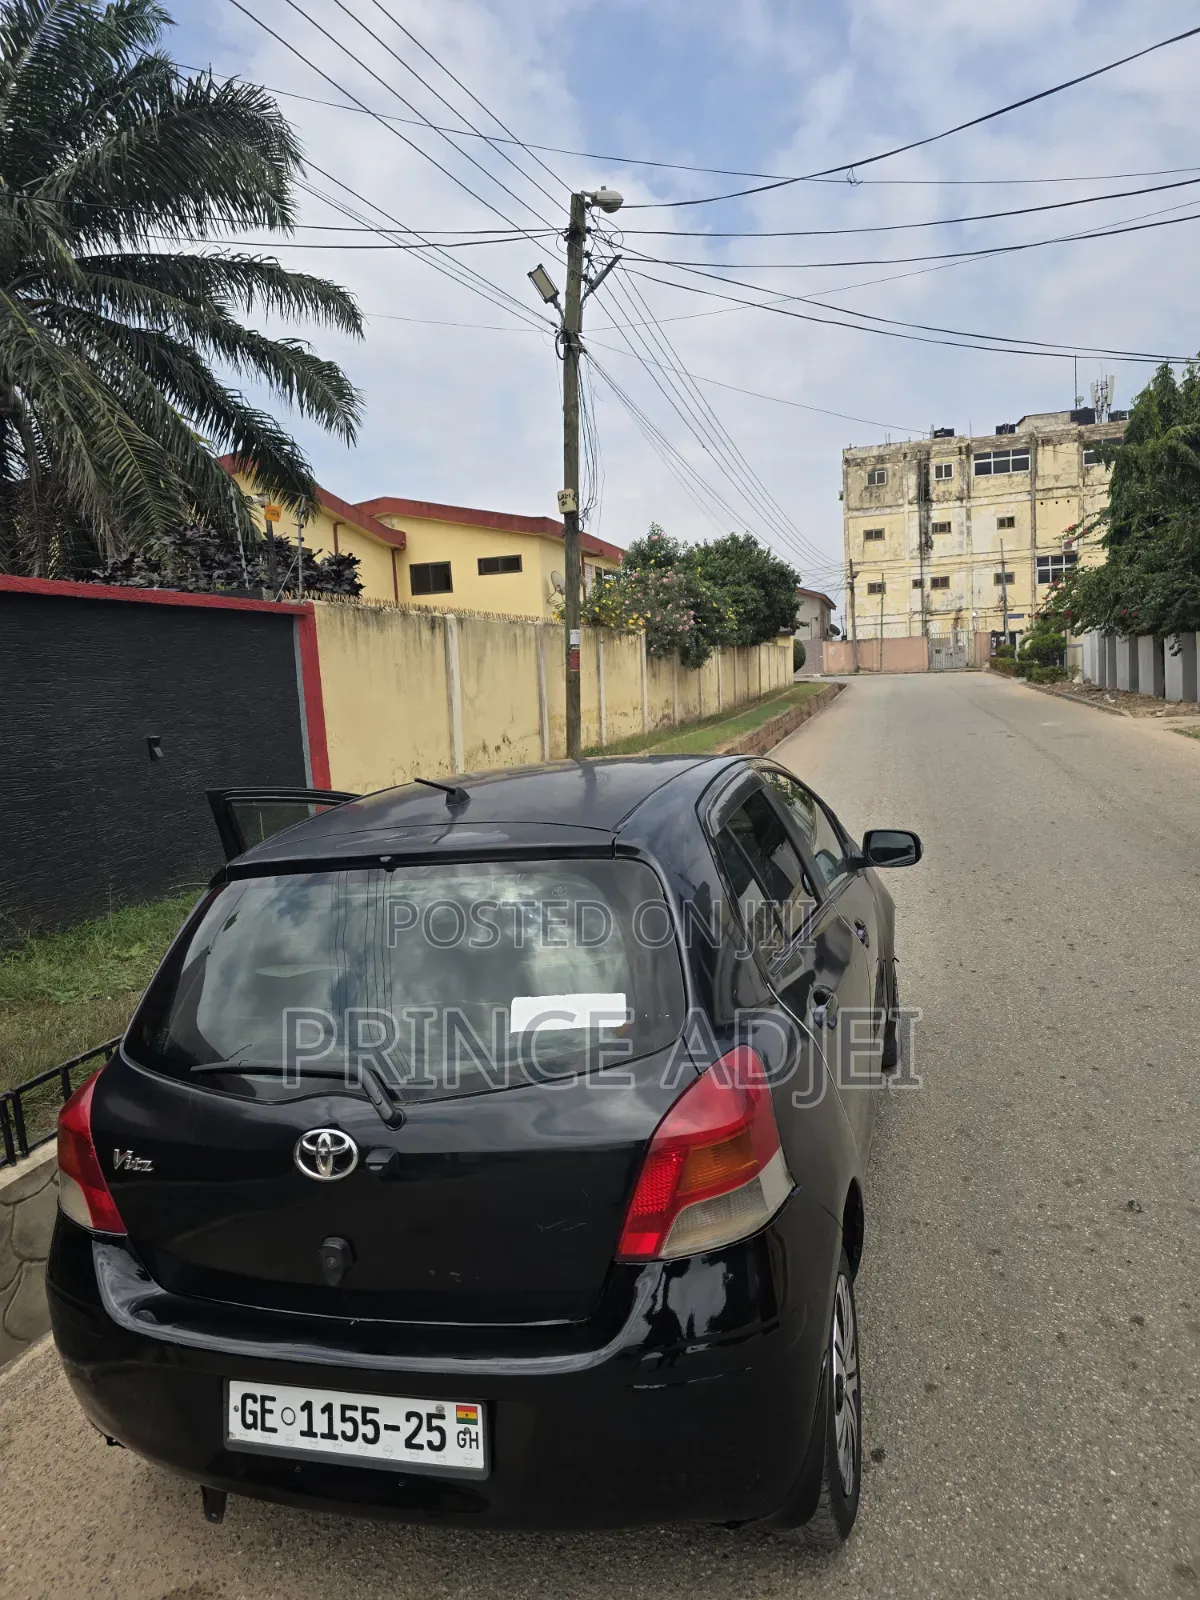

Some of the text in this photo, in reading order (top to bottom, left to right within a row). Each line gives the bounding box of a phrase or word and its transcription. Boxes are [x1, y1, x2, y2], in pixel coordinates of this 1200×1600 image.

[113, 1148, 154, 1171] Vitz
[240, 1392, 447, 1452] GE 1155-25
[456, 1430, 479, 1450] GH
